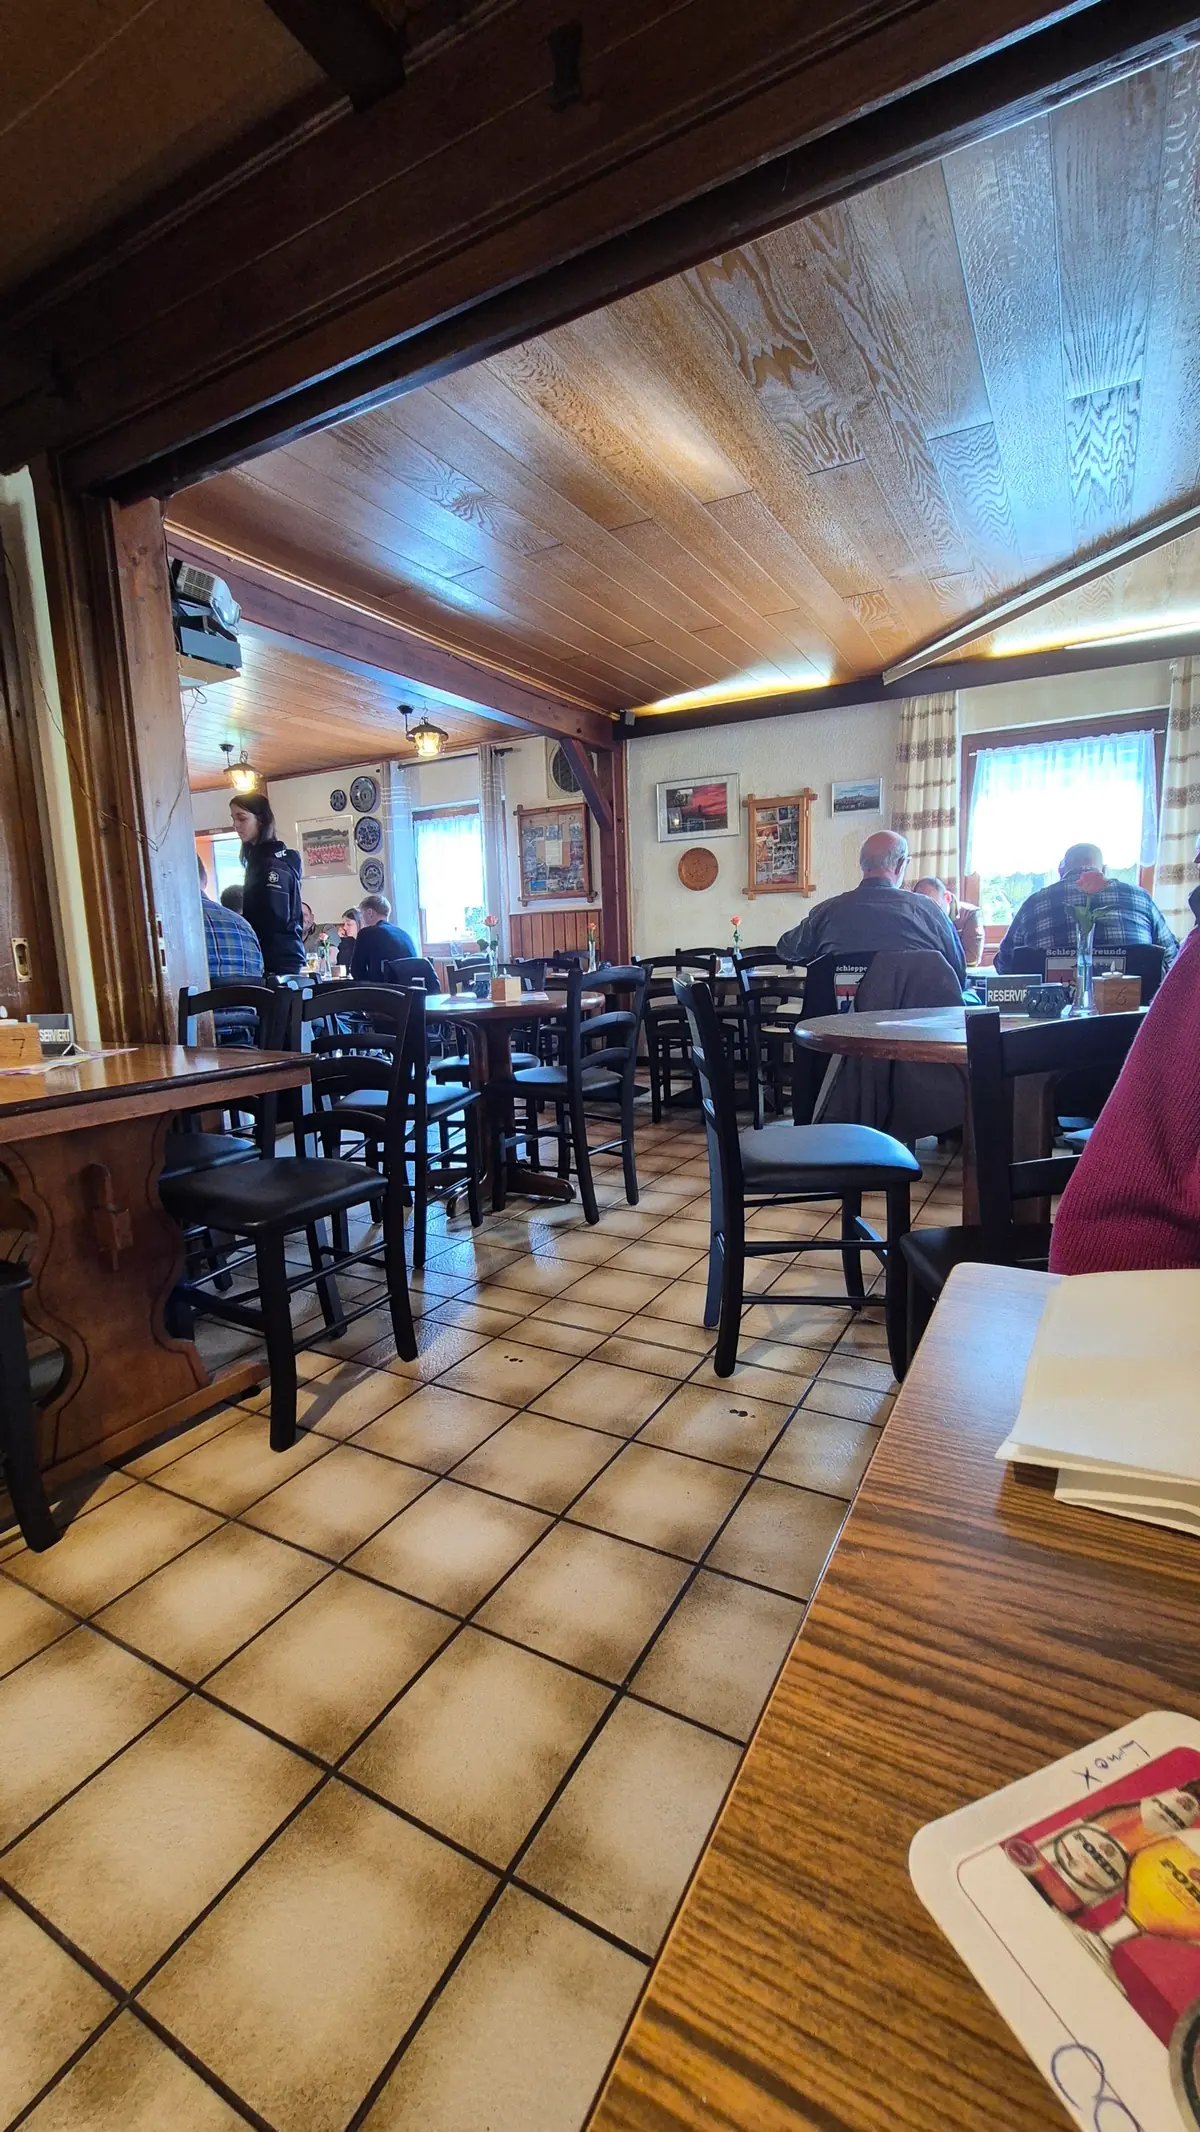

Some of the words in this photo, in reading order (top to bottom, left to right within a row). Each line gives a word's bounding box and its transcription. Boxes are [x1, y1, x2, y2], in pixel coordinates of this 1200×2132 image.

[1045, 947, 1128, 957] Schlepfreunde
[835, 964, 868, 973] Schleppe
[987, 988, 1029, 1003] RESERVIE
[38, 1028, 71, 1043] SERVIERT
